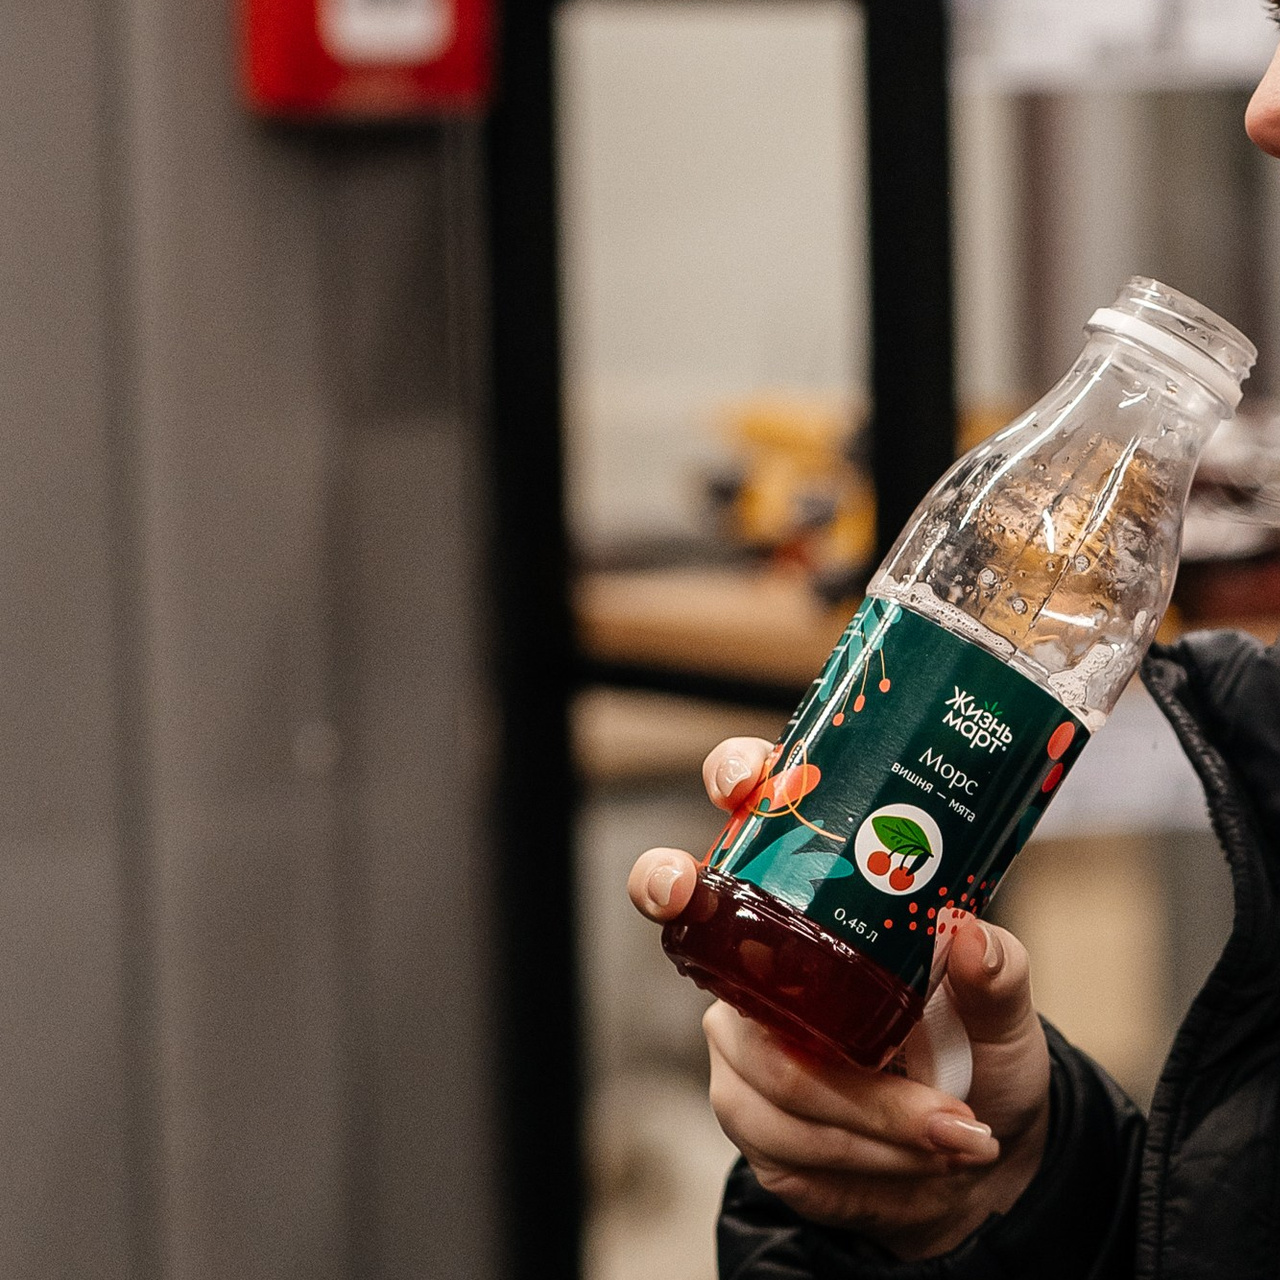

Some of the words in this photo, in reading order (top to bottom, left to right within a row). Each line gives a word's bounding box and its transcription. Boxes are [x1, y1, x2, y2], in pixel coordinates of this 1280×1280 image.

[944, 685, 1013, 744] Жизнь
[890, 762, 934, 794] вишня
[948, 798, 976, 823] мята
[918, 746, 979, 796] Морс
[834, 907, 868, 934] 0,45
